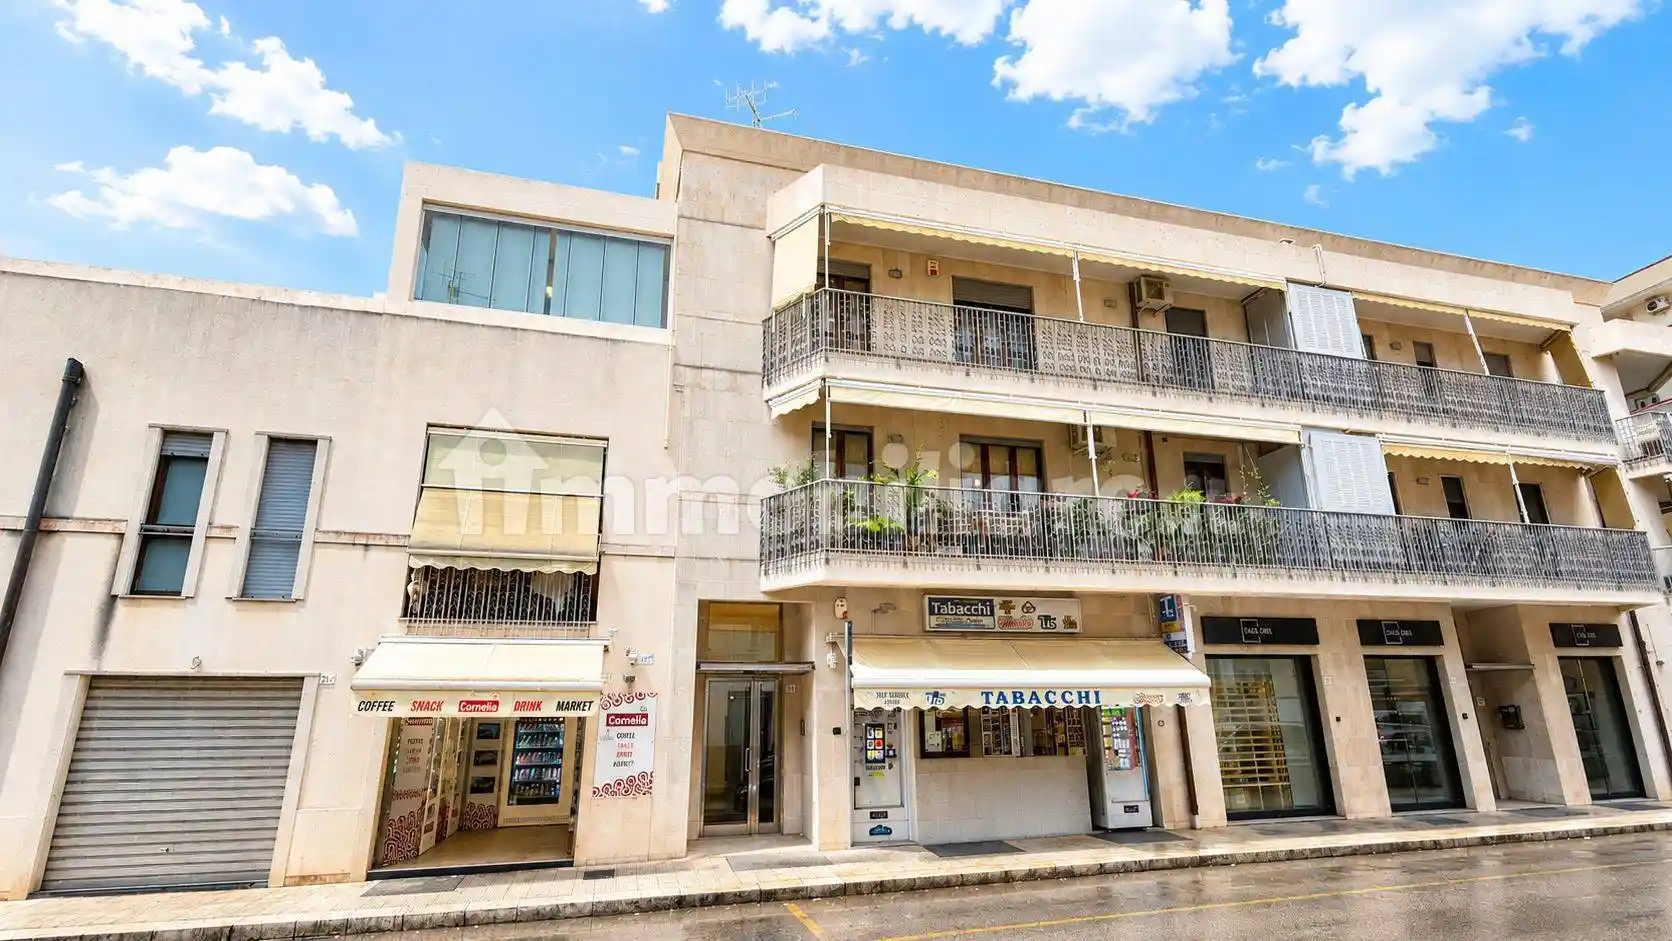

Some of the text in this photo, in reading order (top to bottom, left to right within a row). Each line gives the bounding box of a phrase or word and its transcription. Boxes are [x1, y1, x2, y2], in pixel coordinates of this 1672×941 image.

[932, 601, 991, 615] Tabacchi
[981, 690, 1101, 704] TABACCHI
[357, 701, 396, 712] COFFEE
[411, 701, 444, 712] SNACK
[513, 701, 543, 712] DRINK
[555, 701, 594, 711] MARKET
